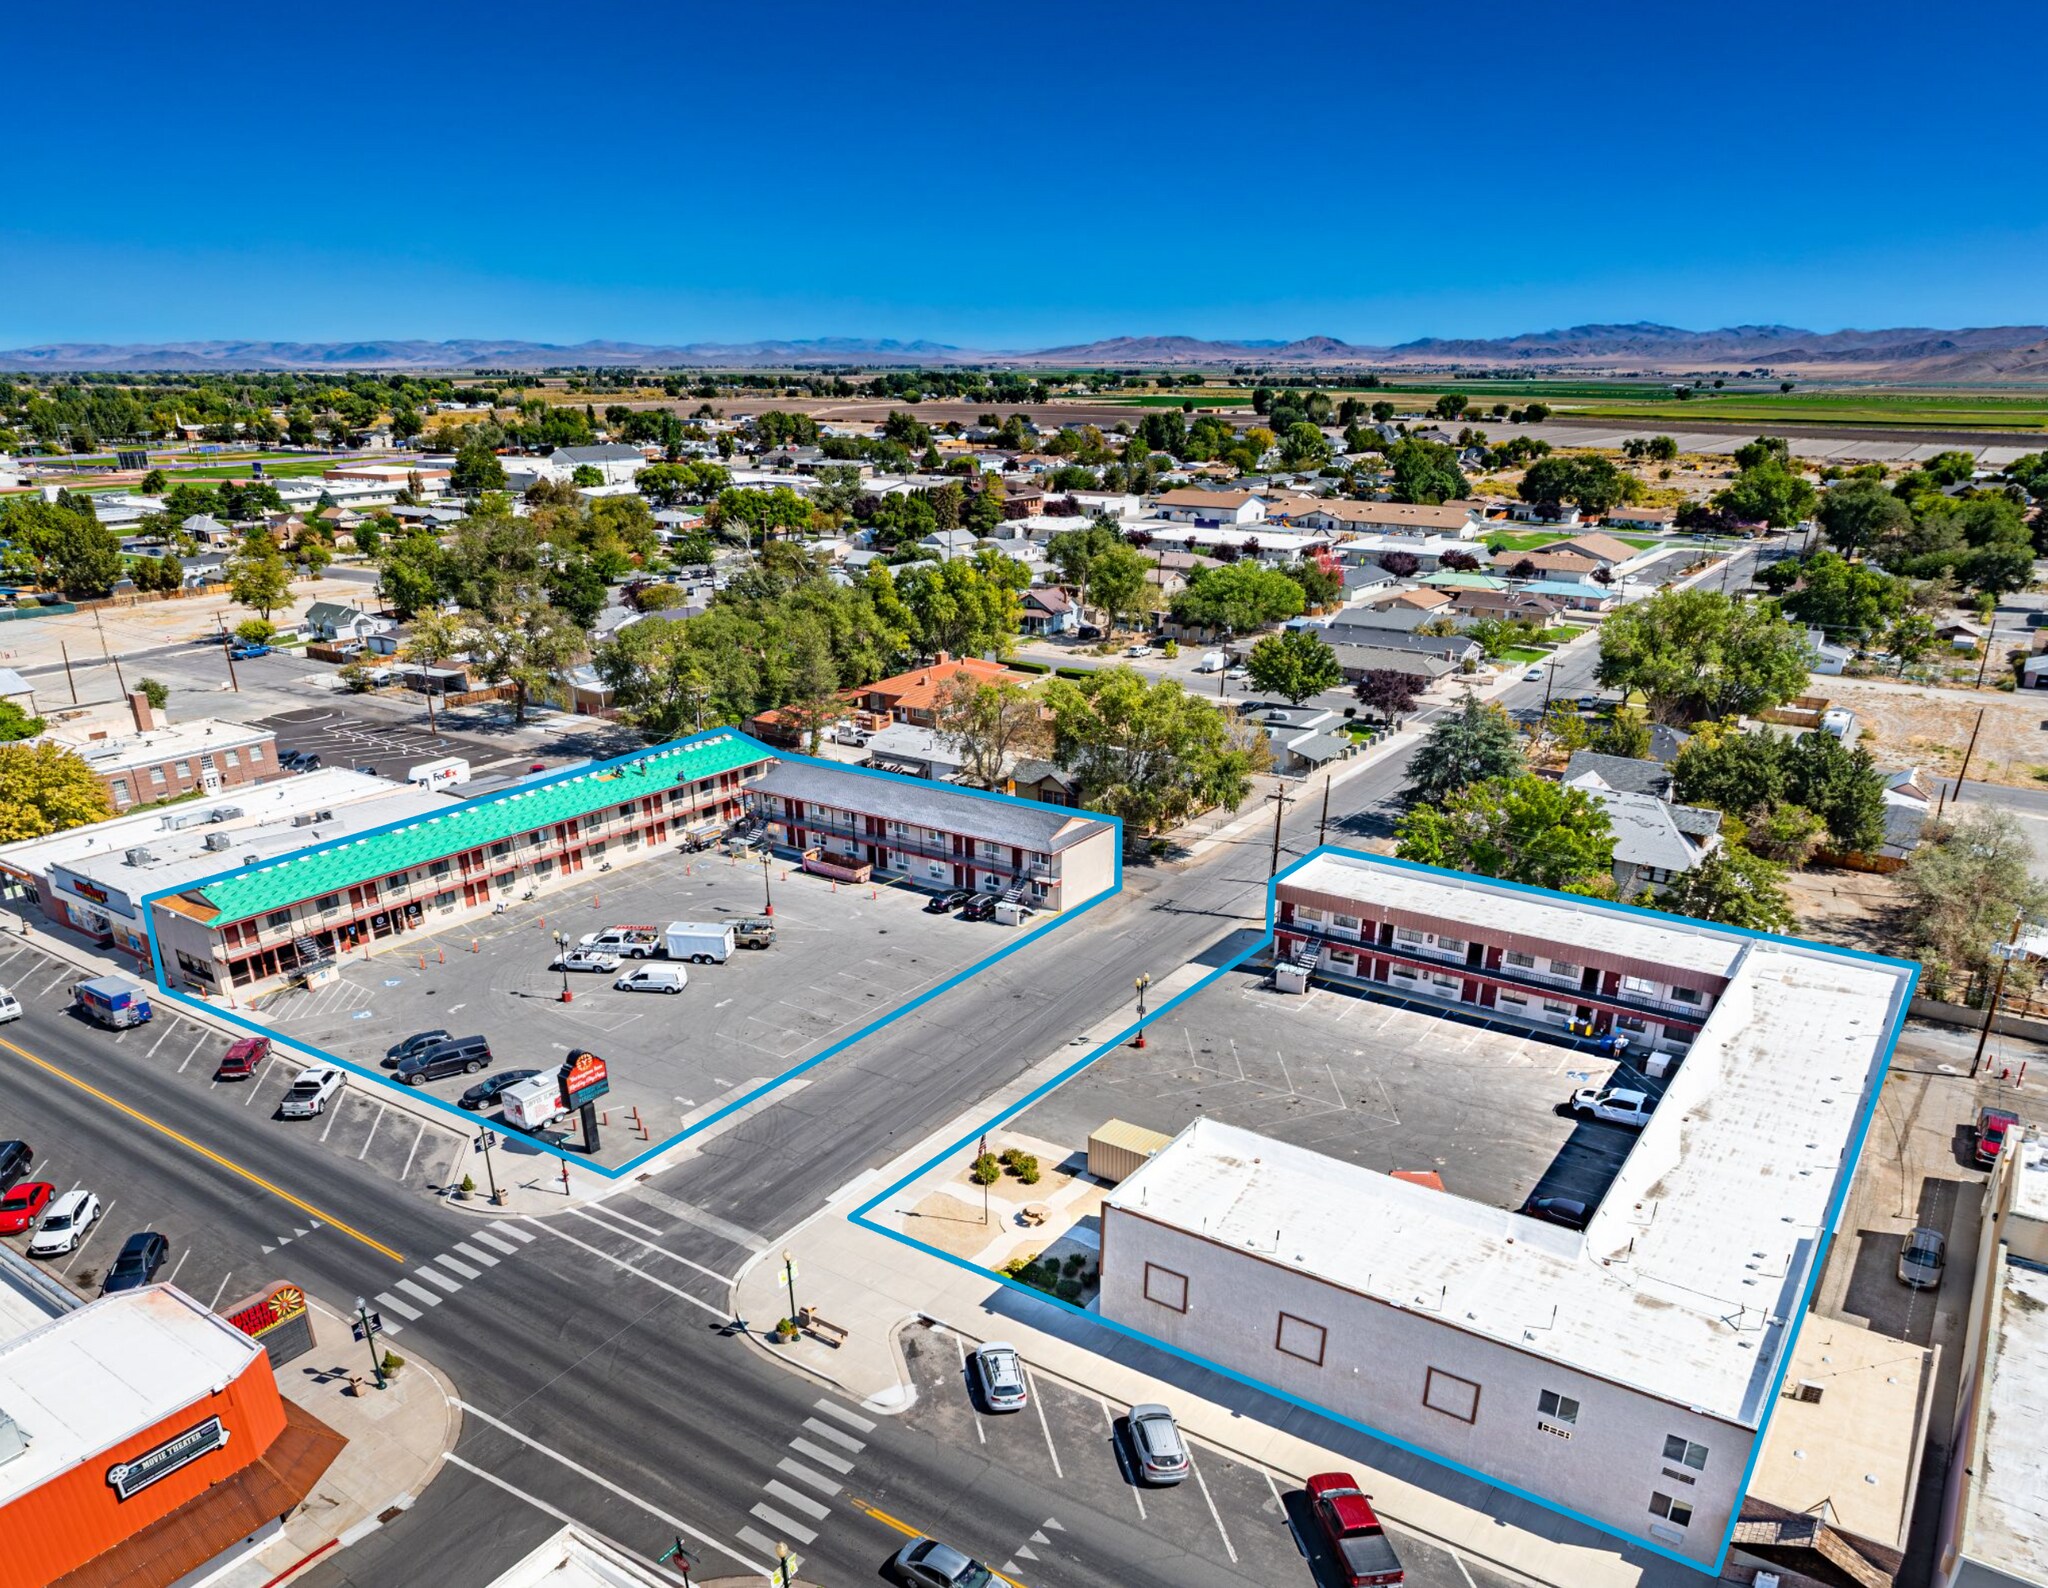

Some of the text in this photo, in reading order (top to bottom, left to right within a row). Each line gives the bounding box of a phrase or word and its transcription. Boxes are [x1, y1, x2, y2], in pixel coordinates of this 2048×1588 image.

[433, 769, 457, 781] FedEx
[228, 1301, 269, 1328] IONEER
[241, 1309, 279, 1336] OSSING
[141, 1451, 167, 1470] MOVIE
[168, 1432, 202, 1456] THEATER
